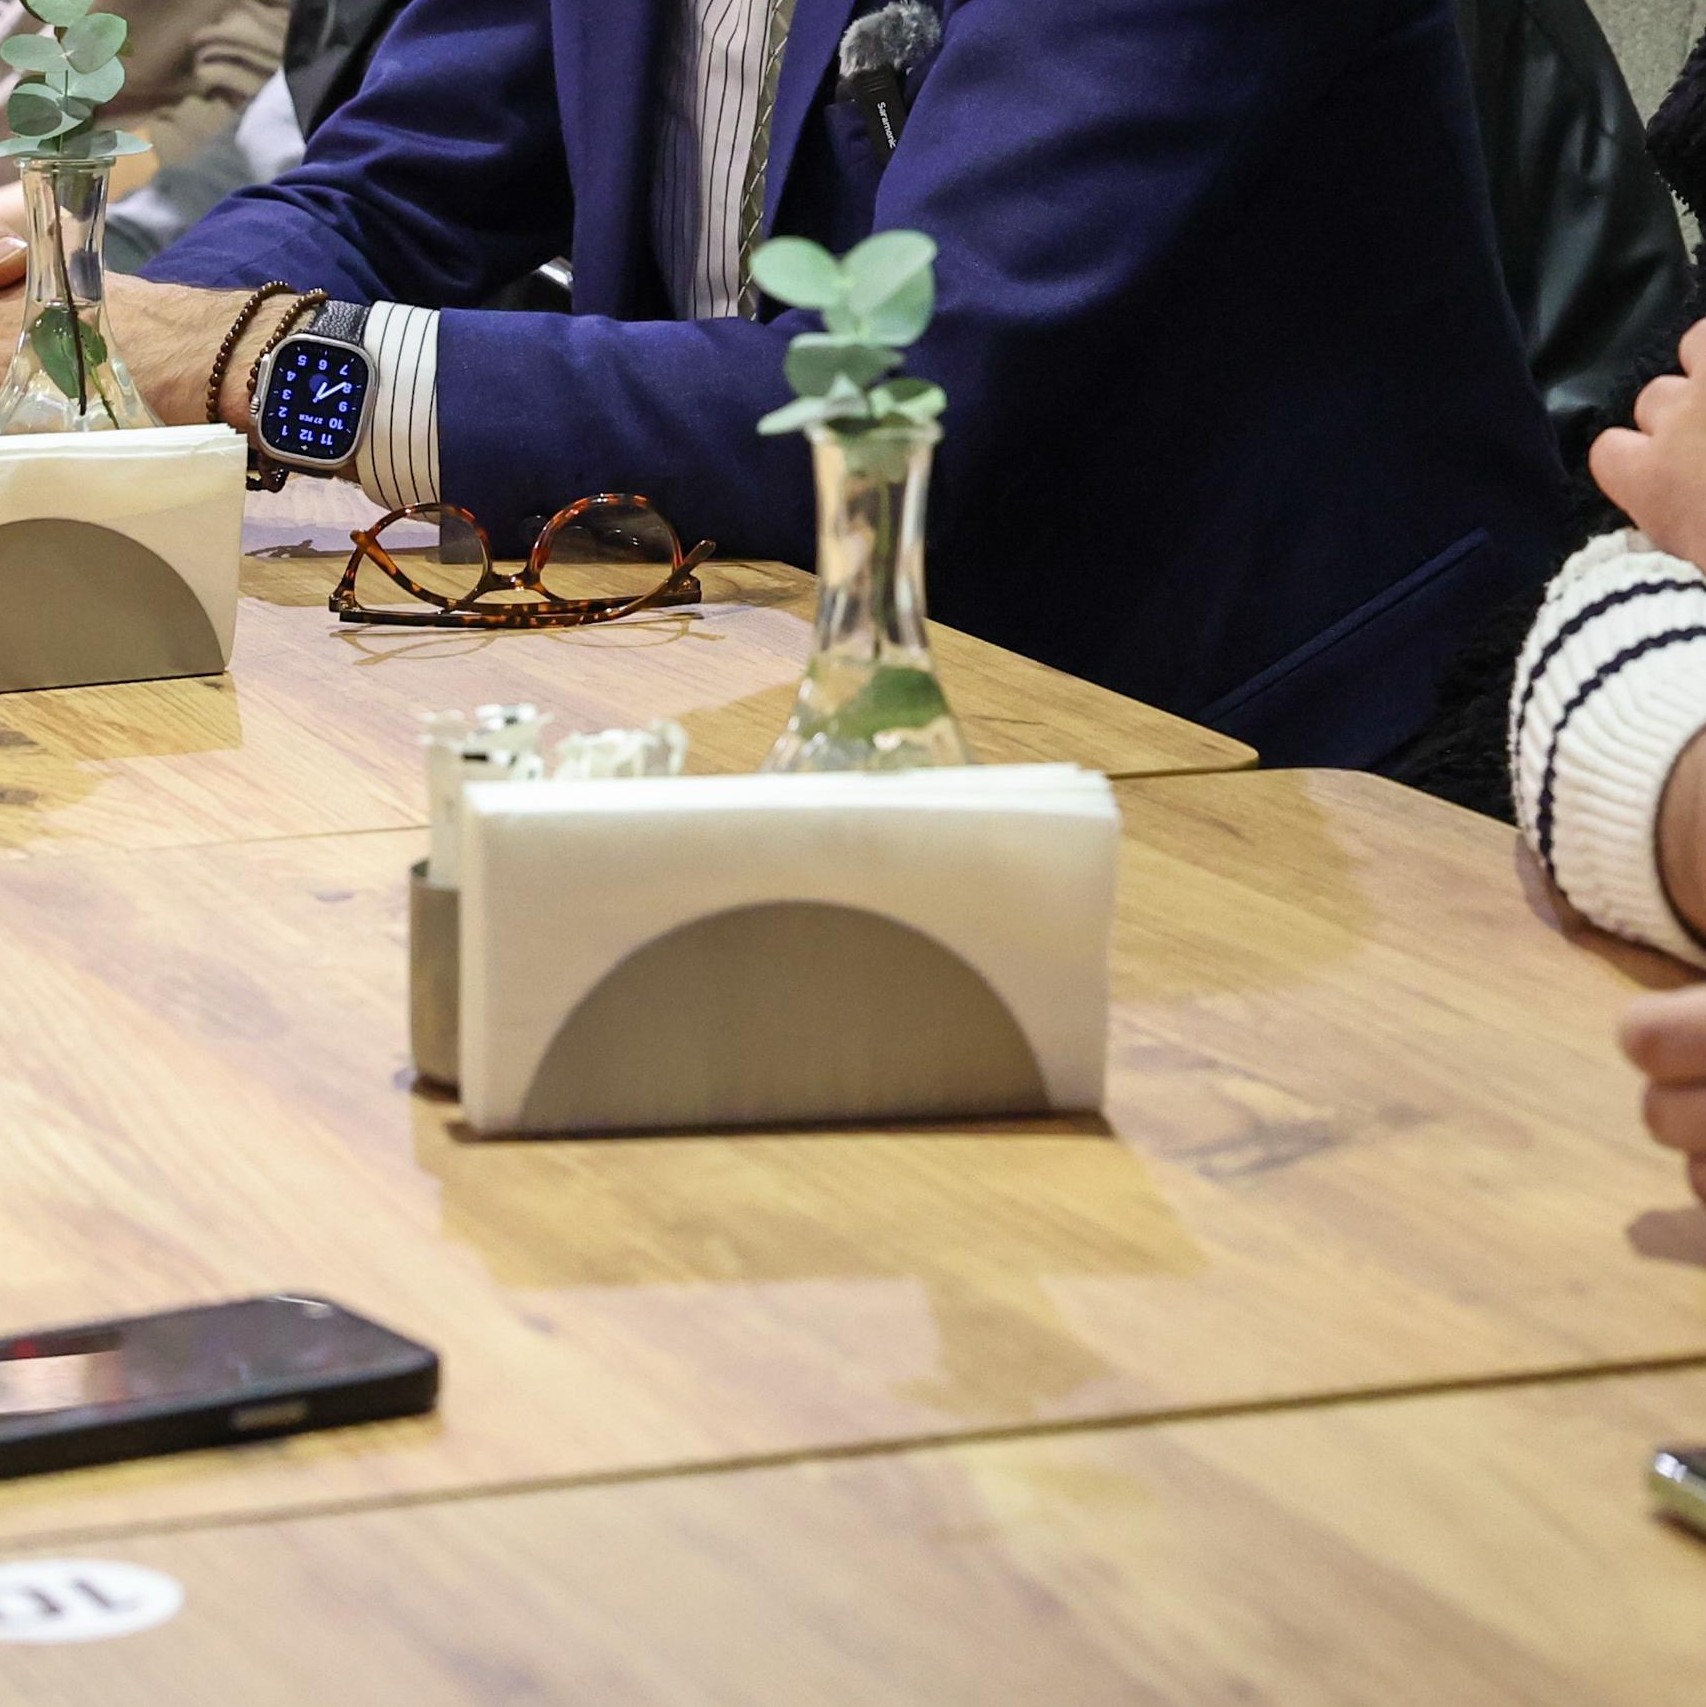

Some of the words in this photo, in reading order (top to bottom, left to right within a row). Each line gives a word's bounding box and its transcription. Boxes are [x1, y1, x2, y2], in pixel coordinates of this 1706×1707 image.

[877, 101, 897, 150] Saramonic
[297, 354, 307, 366] 5
[318, 359, 327, 370] 6
[339, 364, 348, 375] 7
[286, 370, 296, 381] 4
[282, 389, 291, 399] 3
[278, 406, 287, 417] 2
[338, 401, 347, 412] 9
[328, 417, 343, 429] 10
[281, 424, 288, 435] 1
[299, 428, 313, 441] 12
[320, 433, 332, 445] 11
